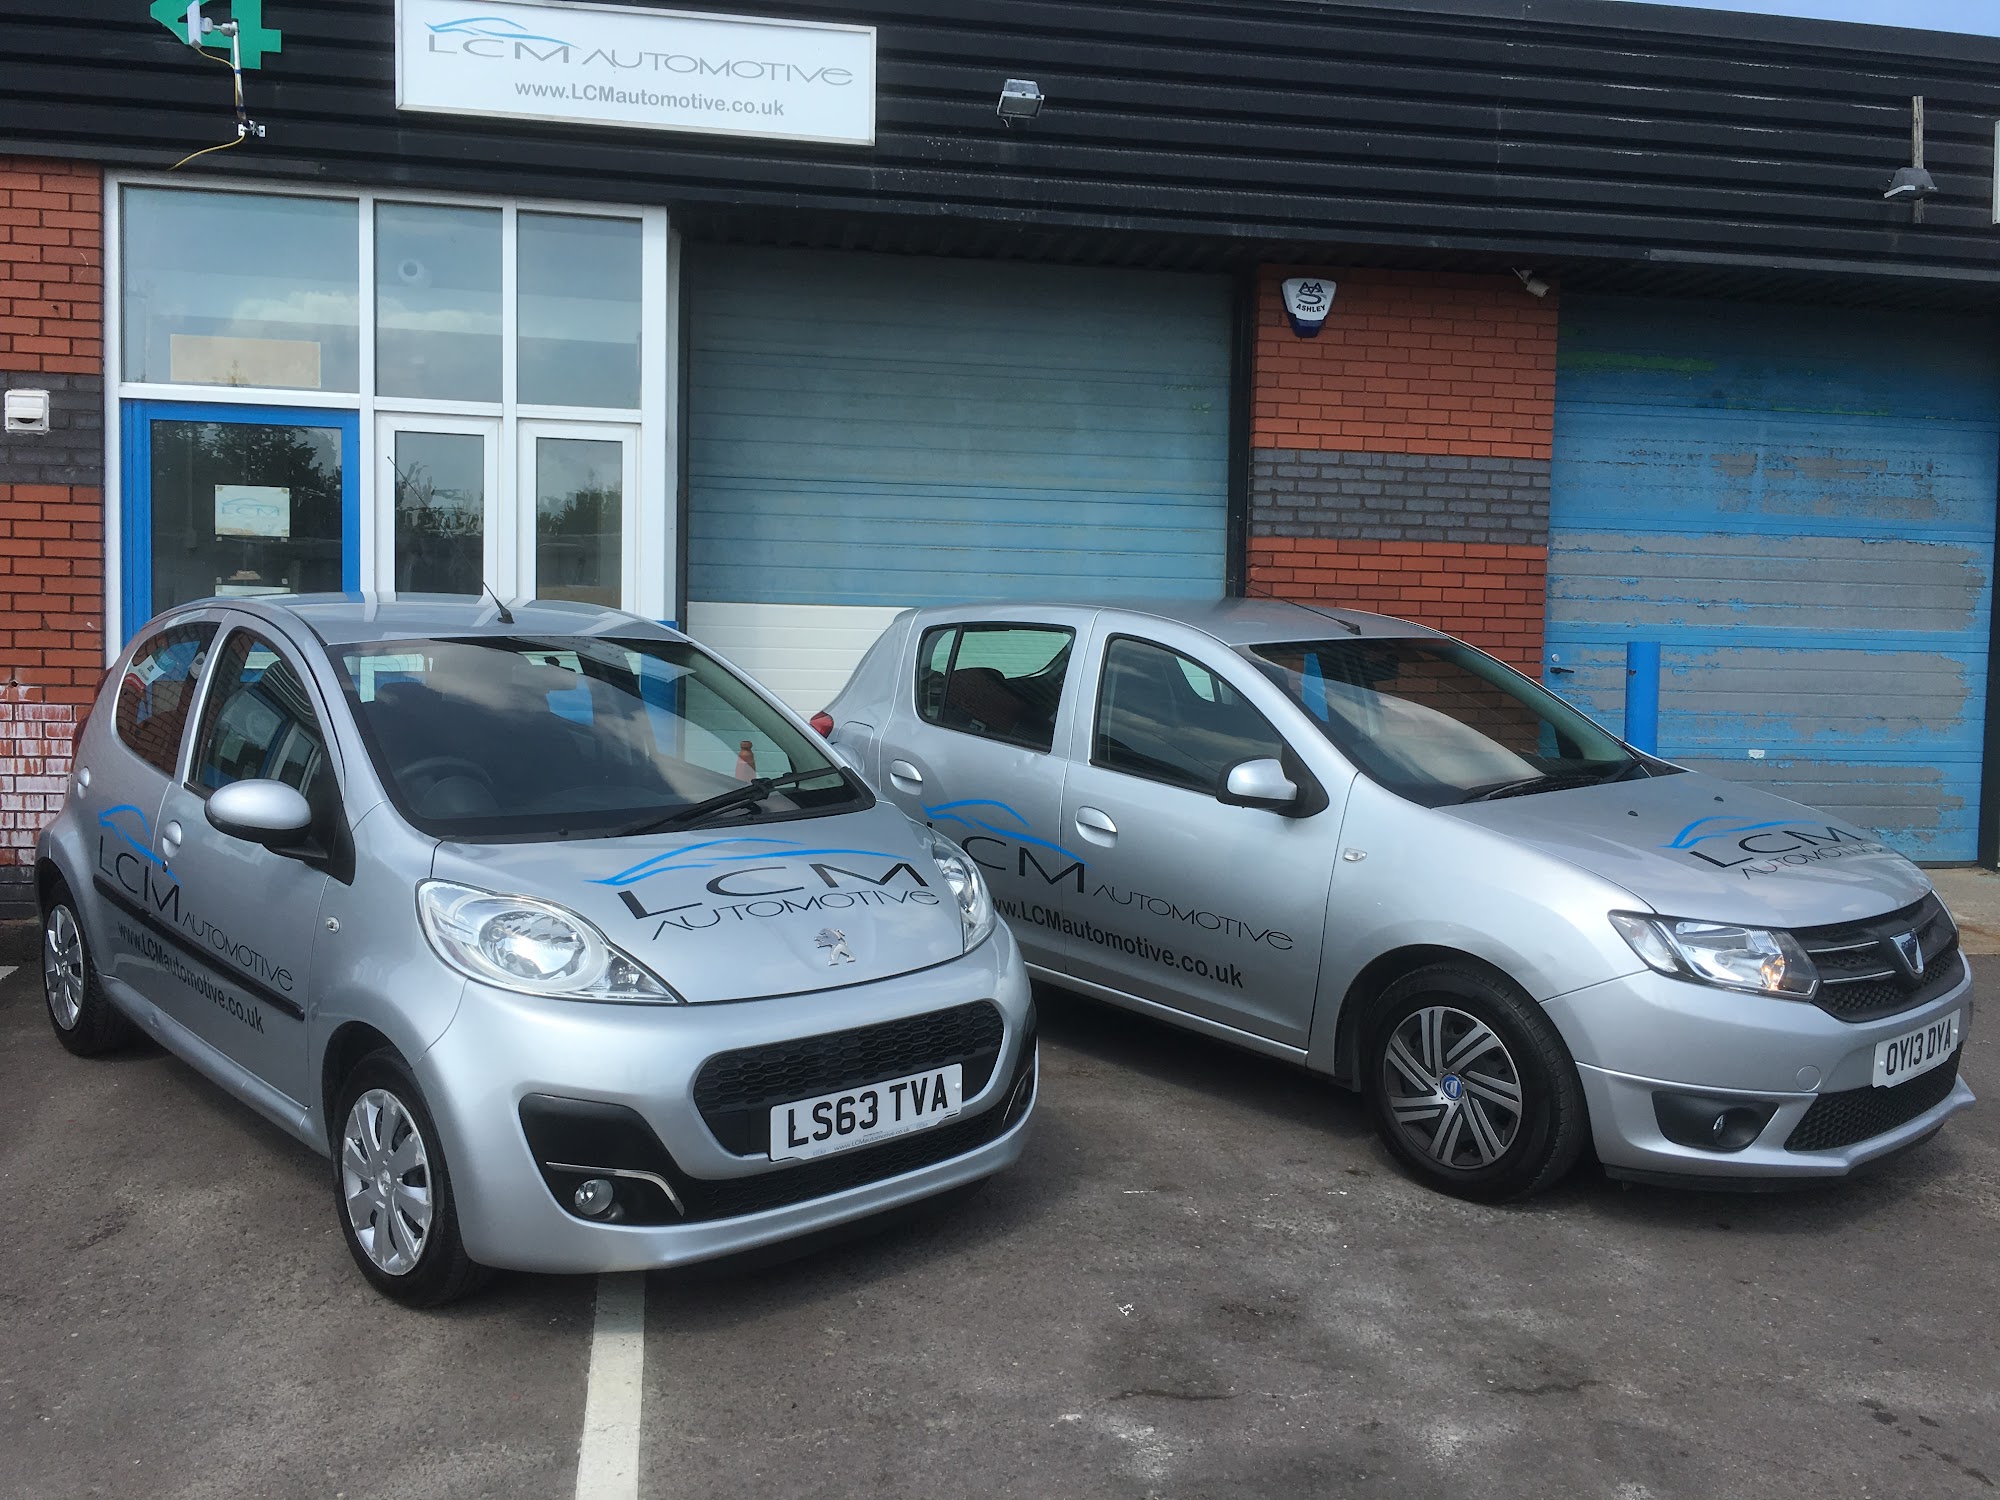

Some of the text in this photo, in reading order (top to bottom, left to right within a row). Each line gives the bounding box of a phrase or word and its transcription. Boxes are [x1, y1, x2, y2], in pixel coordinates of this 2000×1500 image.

[428, 33, 569, 64] LCM
[514, 80, 785, 117] www.LCMautomotive.co.uk
[1296, 303, 1326, 313] ASHLEY
[221, 505, 280, 517] LCM
[926, 821, 1086, 894] CM
[1688, 826, 1863, 869] LCM
[99, 834, 181, 923] LCM
[616, 862, 930, 920] LCM
[992, 896, 1244, 989] ww.LCMautomotive.co.uk
[117, 922, 264, 1035] www.LCMautomotive.co.uk
[1886, 1018, 1951, 1076] OY13 DYA
[787, 1073, 949, 1149] LS63 TVA
